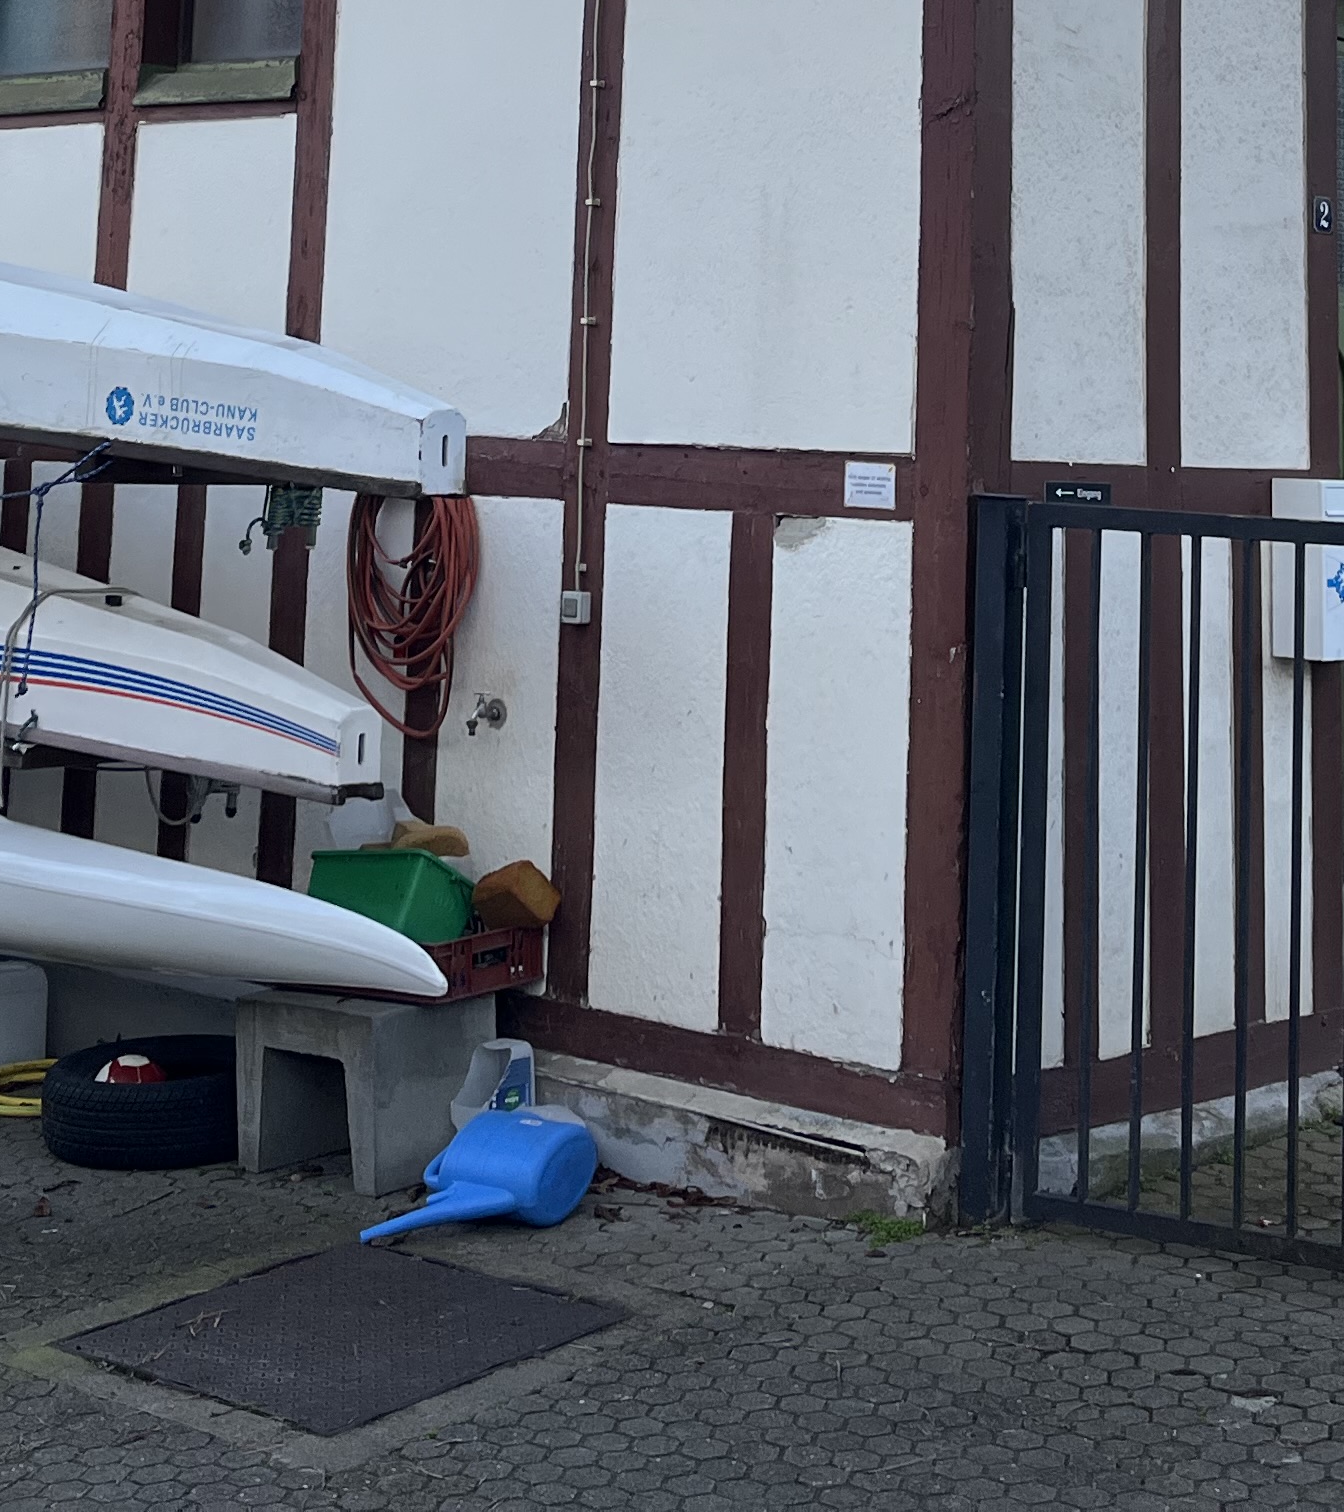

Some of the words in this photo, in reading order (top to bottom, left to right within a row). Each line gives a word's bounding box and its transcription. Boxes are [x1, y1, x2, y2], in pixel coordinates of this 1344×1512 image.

[1319, 201, 1329, 228] 2
[169, 397, 258, 423] KANU-CLUB
[138, 411, 256, 442] SAARBRÜCKER
